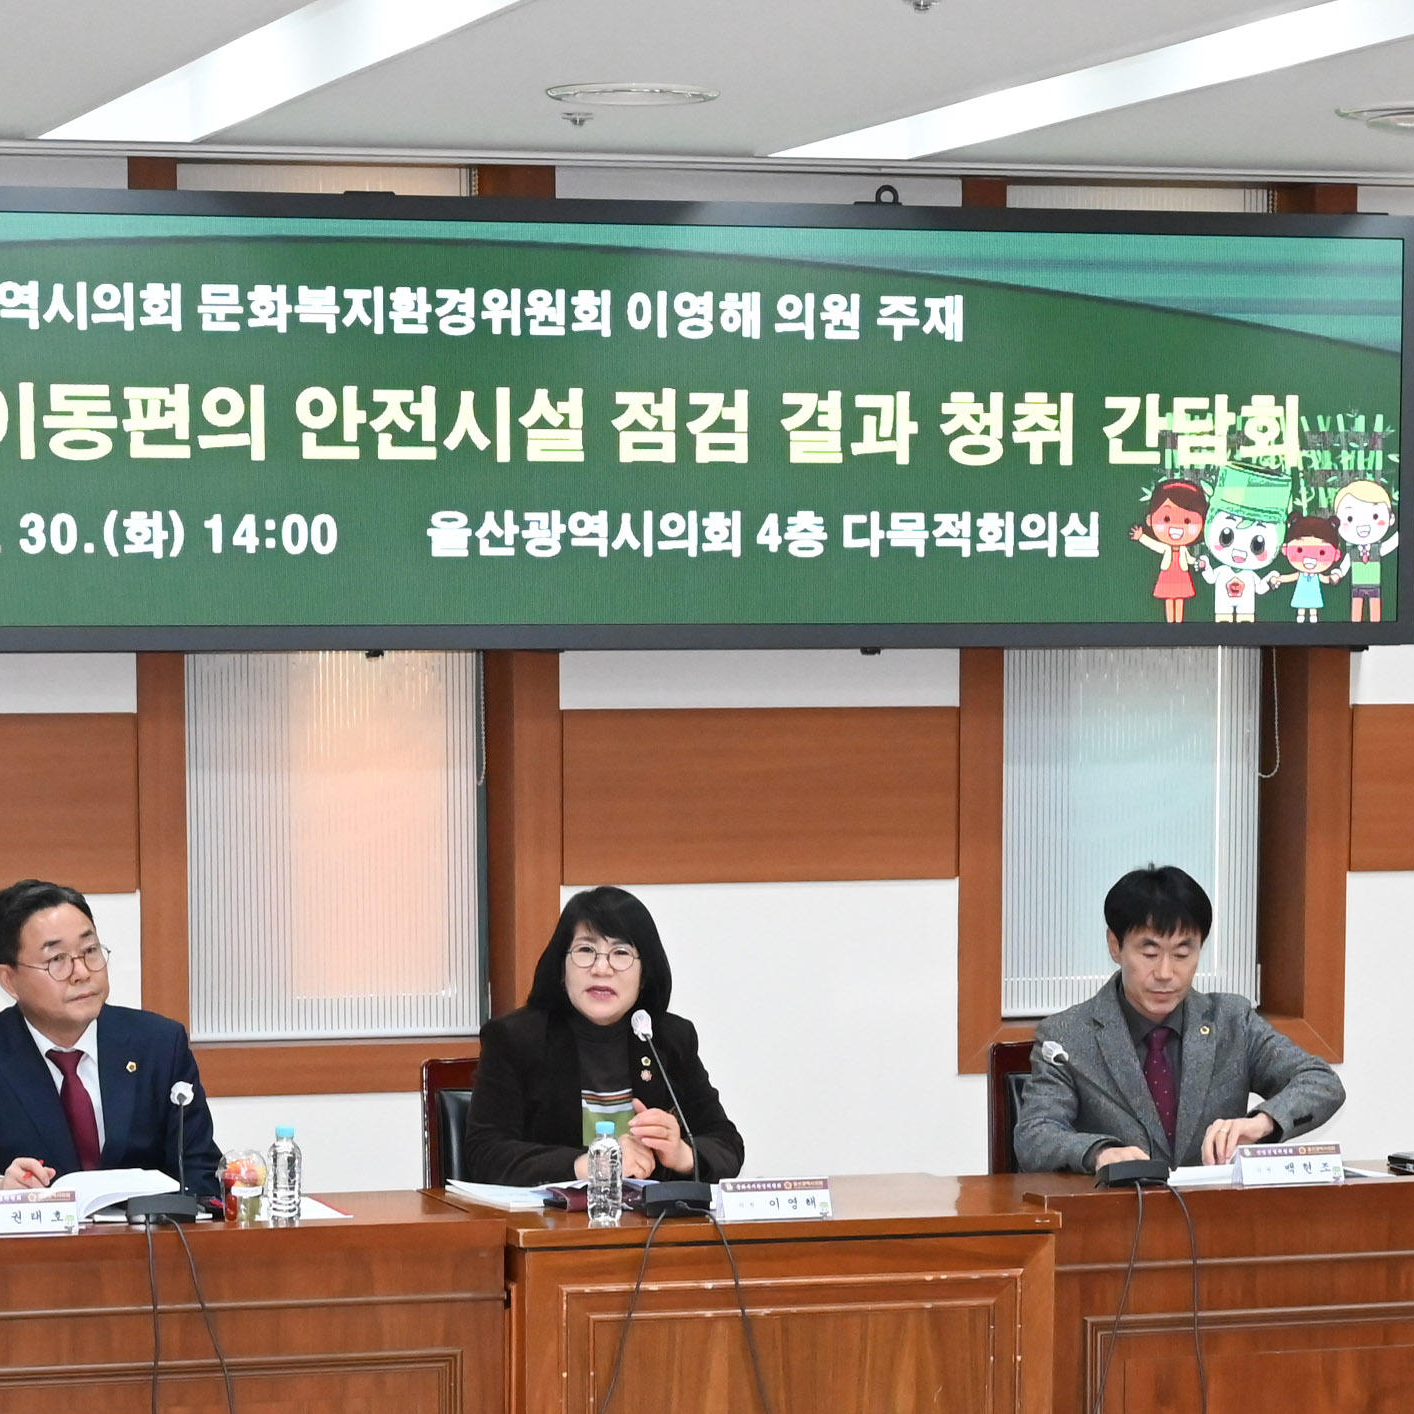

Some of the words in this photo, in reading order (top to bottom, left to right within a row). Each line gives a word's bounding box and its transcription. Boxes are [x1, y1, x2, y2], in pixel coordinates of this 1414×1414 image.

[197, 283, 612, 338] 문화복지환경위원회
[626, 290, 761, 340] 이영해
[774, 292, 861, 340] 의원
[876, 294, 964, 342] 주재
[295, 385, 585, 463] 안전시설
[611, 387, 749, 464] 점검
[780, 390, 919, 465] 결과
[939, 391, 1074, 466] 청취
[1102, 393, 1301, 467] 간담회
[204, 513, 338, 555] 14:00
[426, 509, 742, 558] 울산광역시의회
[756, 510, 828, 558] 4층
[842, 510, 1100, 558] 다목적회의실
